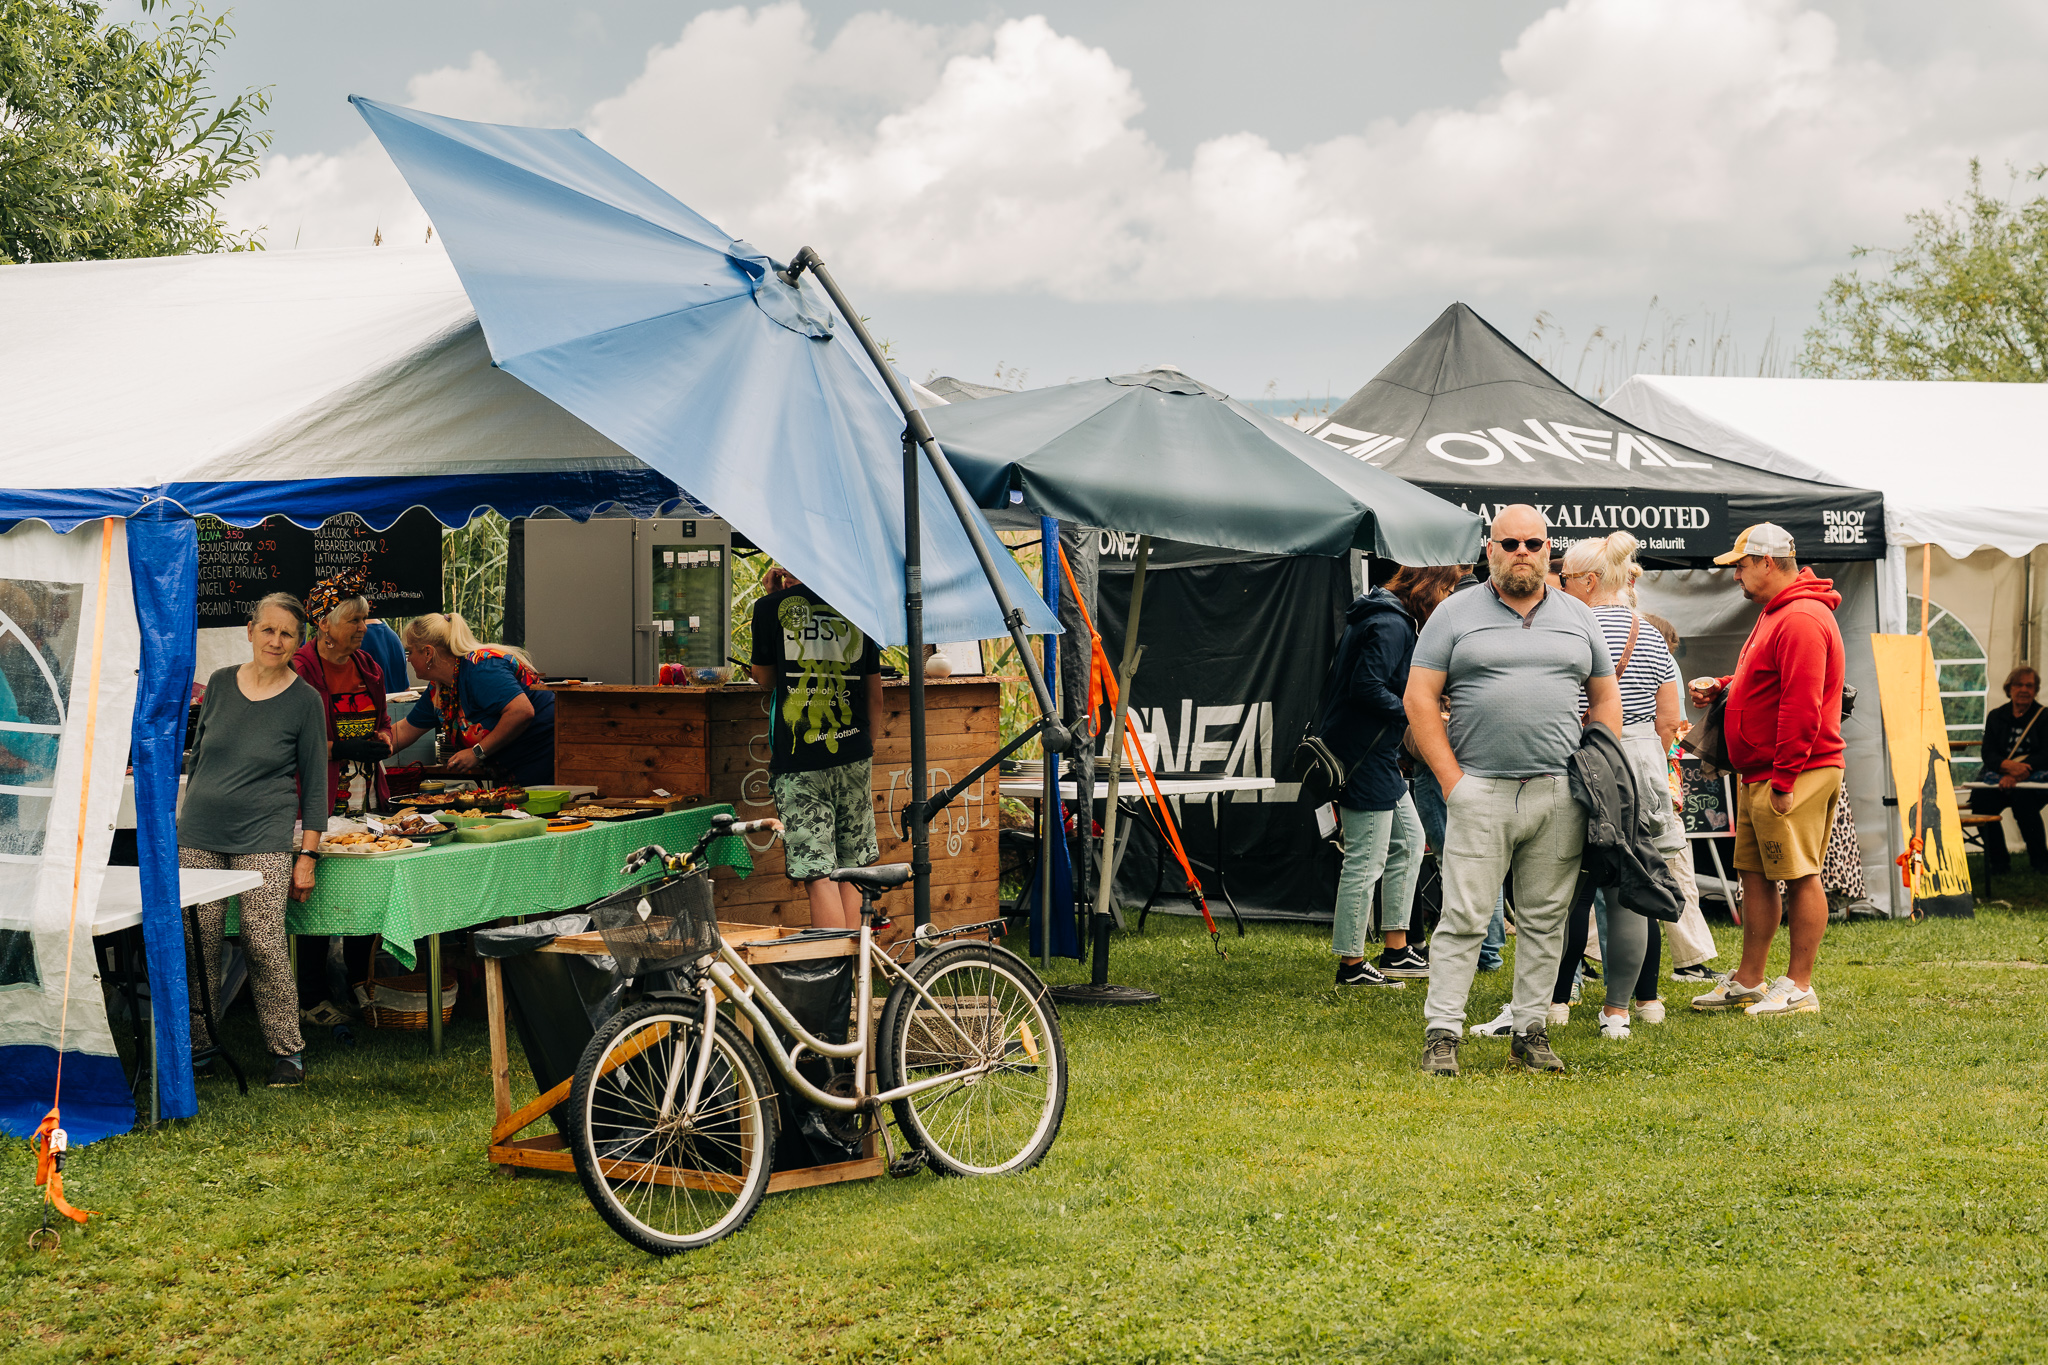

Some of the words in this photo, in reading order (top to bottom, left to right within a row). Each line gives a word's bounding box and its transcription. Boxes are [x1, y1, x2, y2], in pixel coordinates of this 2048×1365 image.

[1535, 504, 1710, 530] KALATOOTED
[1823, 510, 1866, 526] ENJOY
[197, 530, 222, 541] VLOVA
[224, 530, 244, 540] 3.50
[1829, 525, 1868, 544] RIDE.
[257, 539, 277, 552] 3.50
[314, 539, 378, 553] RABARBERIKOOK
[1649, 537, 1686, 550] kalurilt
[234, 565, 268, 580] PIRUKAS
[1686, 815, 1704, 832] 3.-
